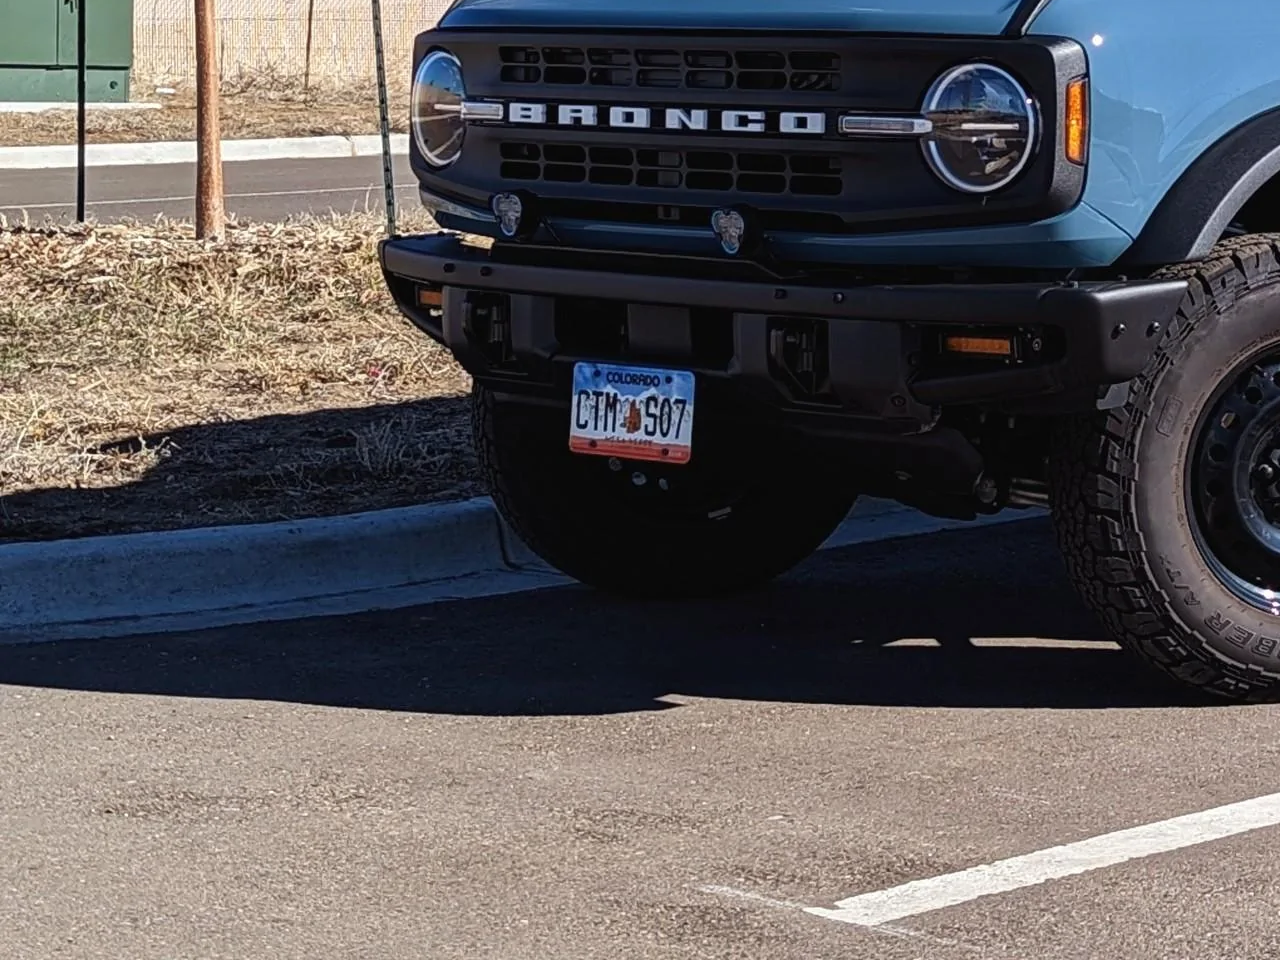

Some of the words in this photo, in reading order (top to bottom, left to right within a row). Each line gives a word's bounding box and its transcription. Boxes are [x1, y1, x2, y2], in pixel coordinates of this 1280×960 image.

[509, 102, 826, 134] BRONCO
[606, 371, 660, 387] COLORADO
[576, 390, 618, 433] CTM
